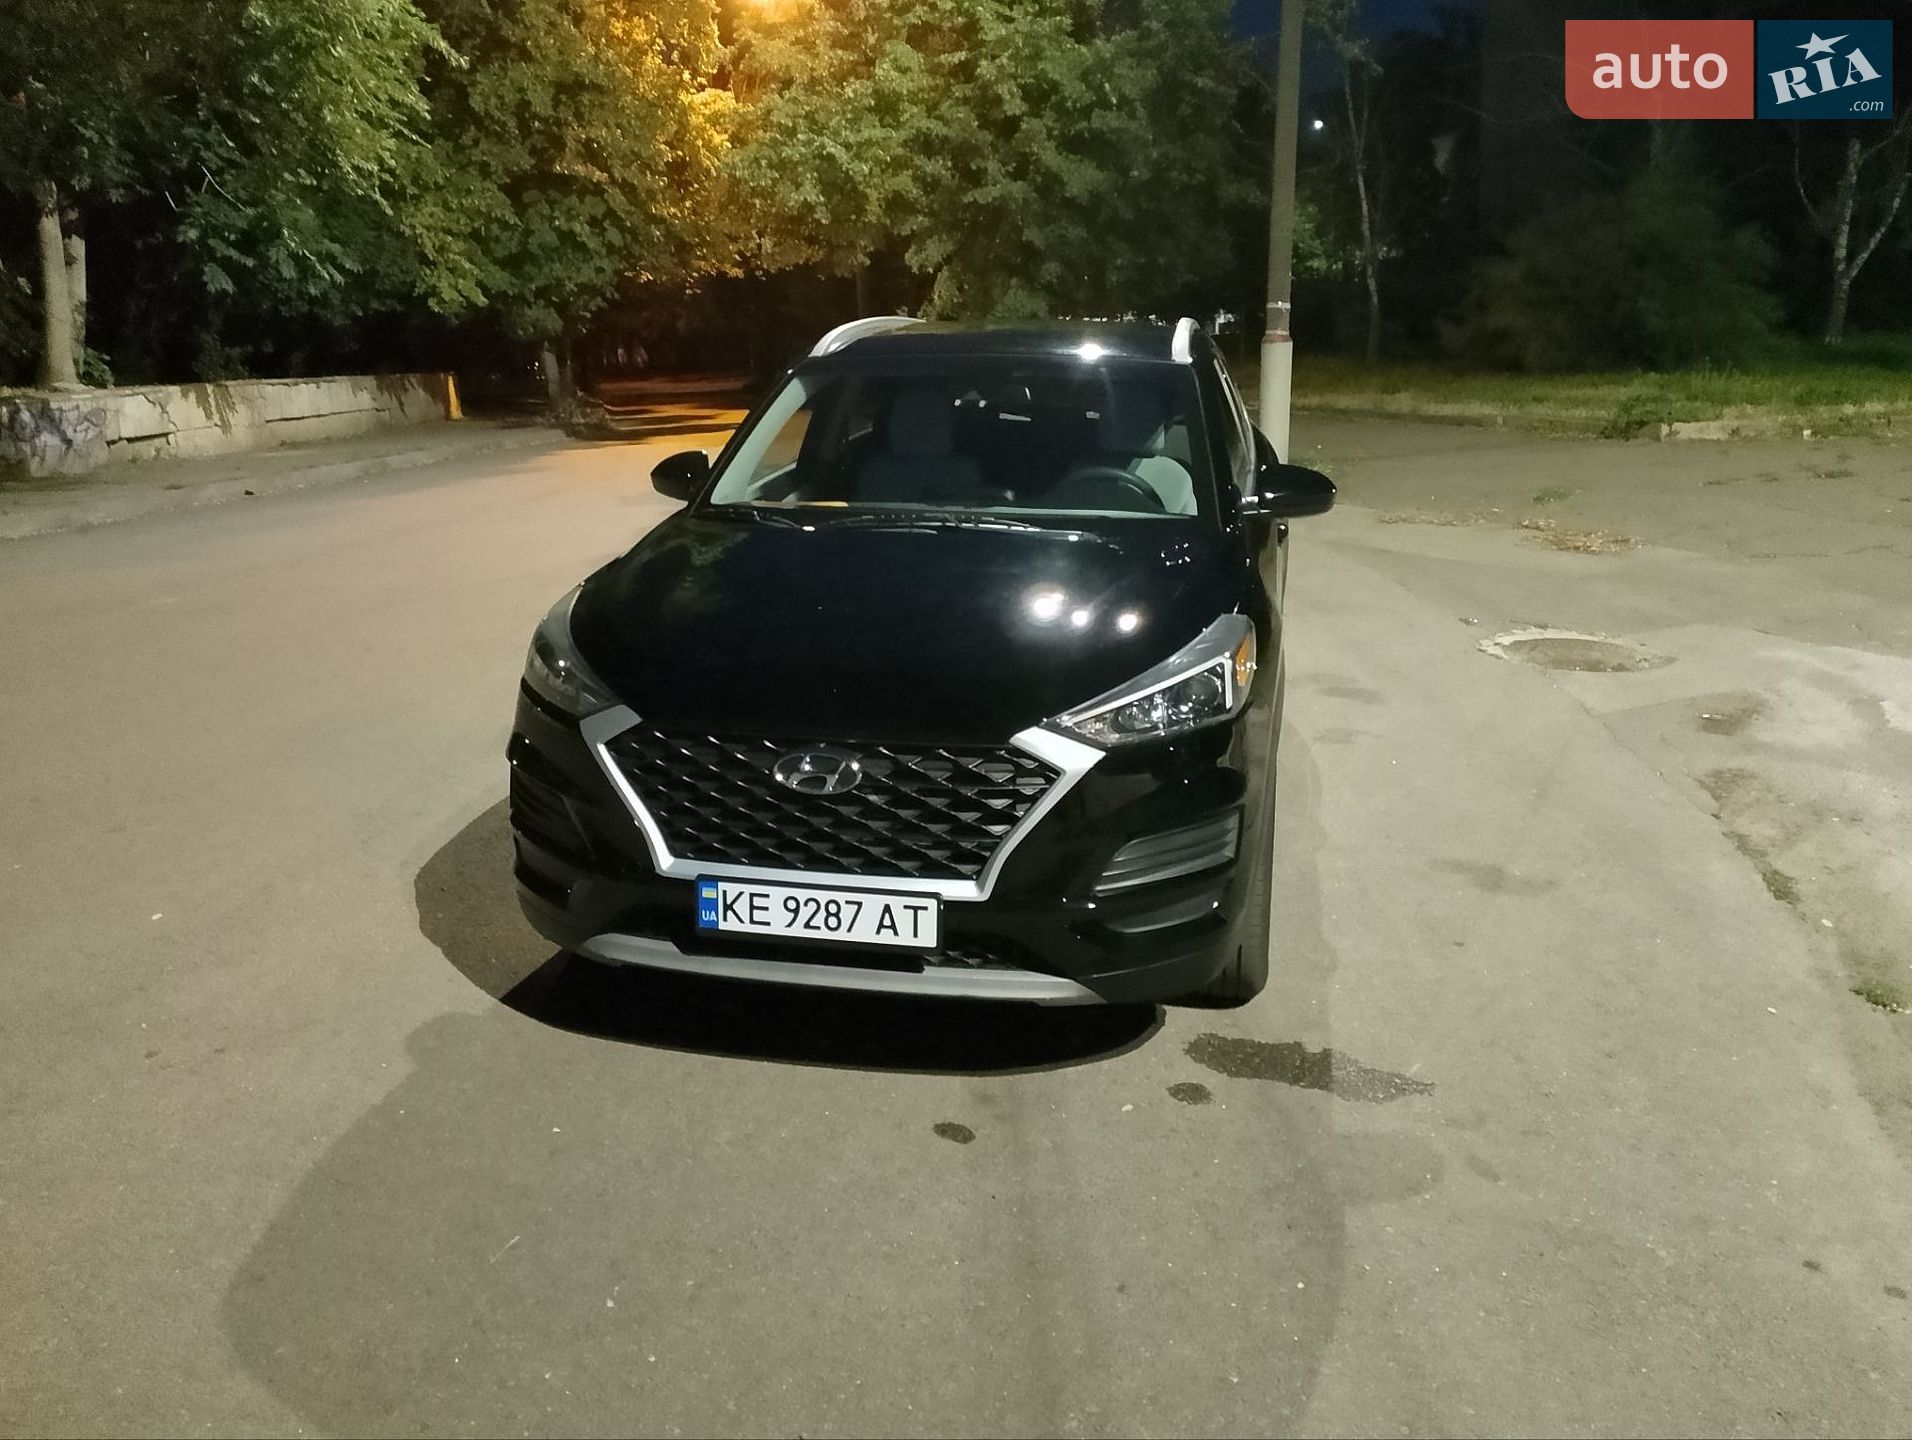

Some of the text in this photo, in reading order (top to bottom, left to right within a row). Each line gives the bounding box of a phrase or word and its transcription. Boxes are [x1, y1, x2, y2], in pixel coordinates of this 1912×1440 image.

[702, 909, 717, 922] UA
[722, 889, 929, 939] KE 9287 AT
